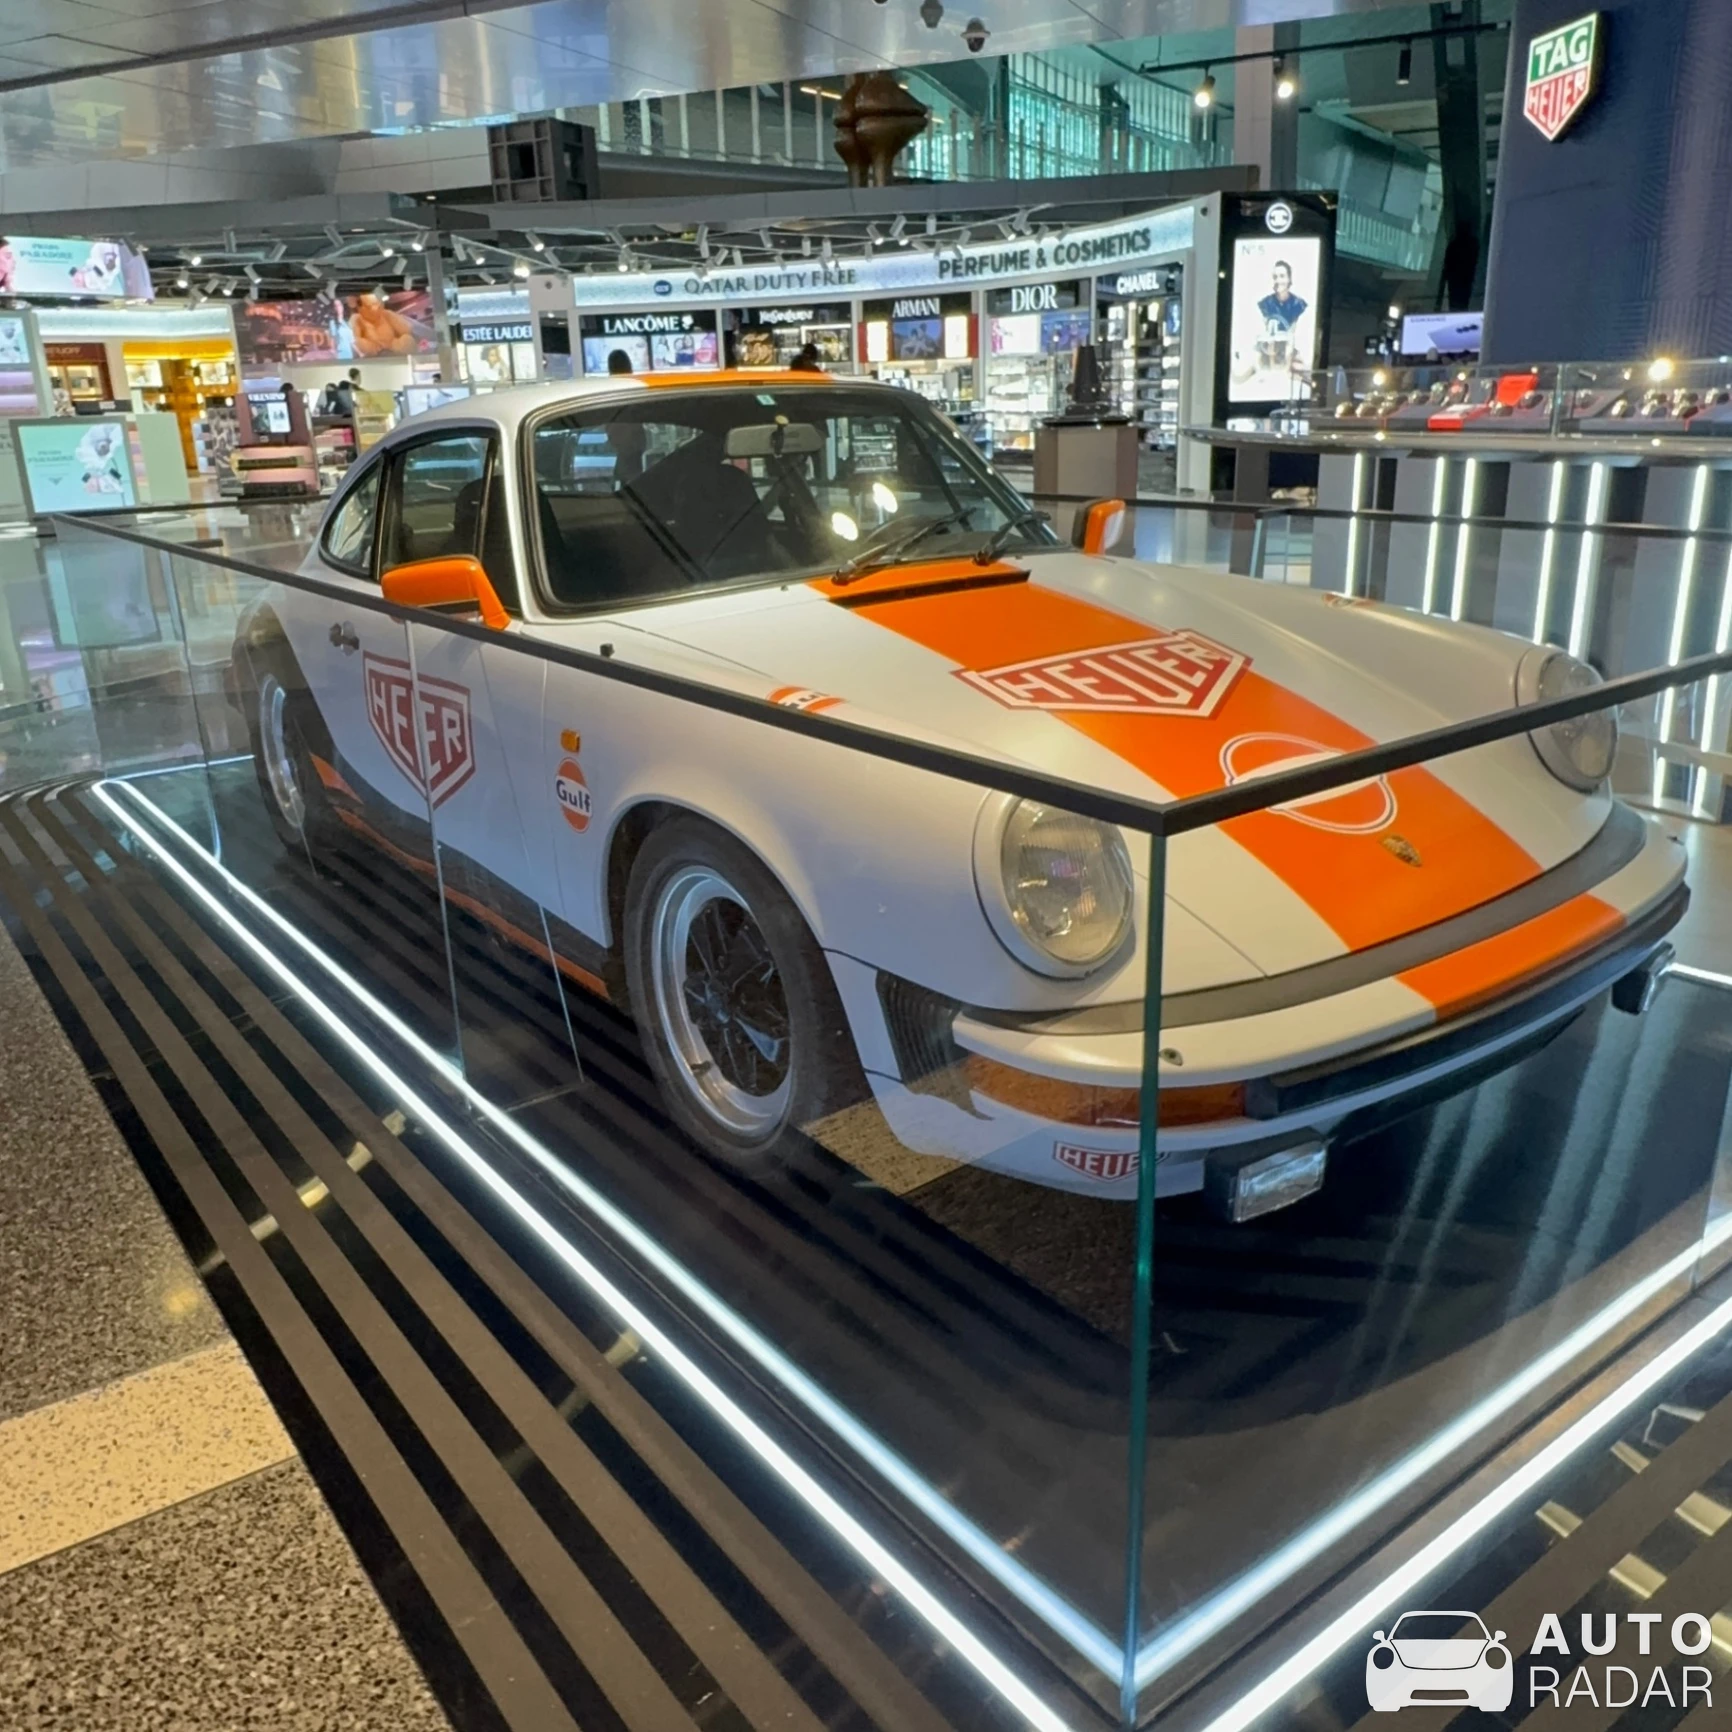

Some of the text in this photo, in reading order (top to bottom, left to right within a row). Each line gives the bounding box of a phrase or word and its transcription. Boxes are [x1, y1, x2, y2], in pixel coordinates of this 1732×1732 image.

[1535, 26, 1588, 77] TAG
[1528, 70, 1586, 130] HEUER
[938, 227, 1150, 279] PERFUME & COSMETICS
[684, 277, 748, 295] QATAR
[754, 272, 806, 291] DUTY
[811, 268, 856, 287] FREE
[1116, 272, 1160, 295] CHANEL
[892, 297, 940, 319] ARMANI
[1011, 284, 1058, 313] DIOR
[603, 314, 680, 334] LANCÔME
[993, 640, 1231, 705] HEUER
[555, 778, 591, 814] Gulf
[1062, 1147, 1145, 1178] HEUE
